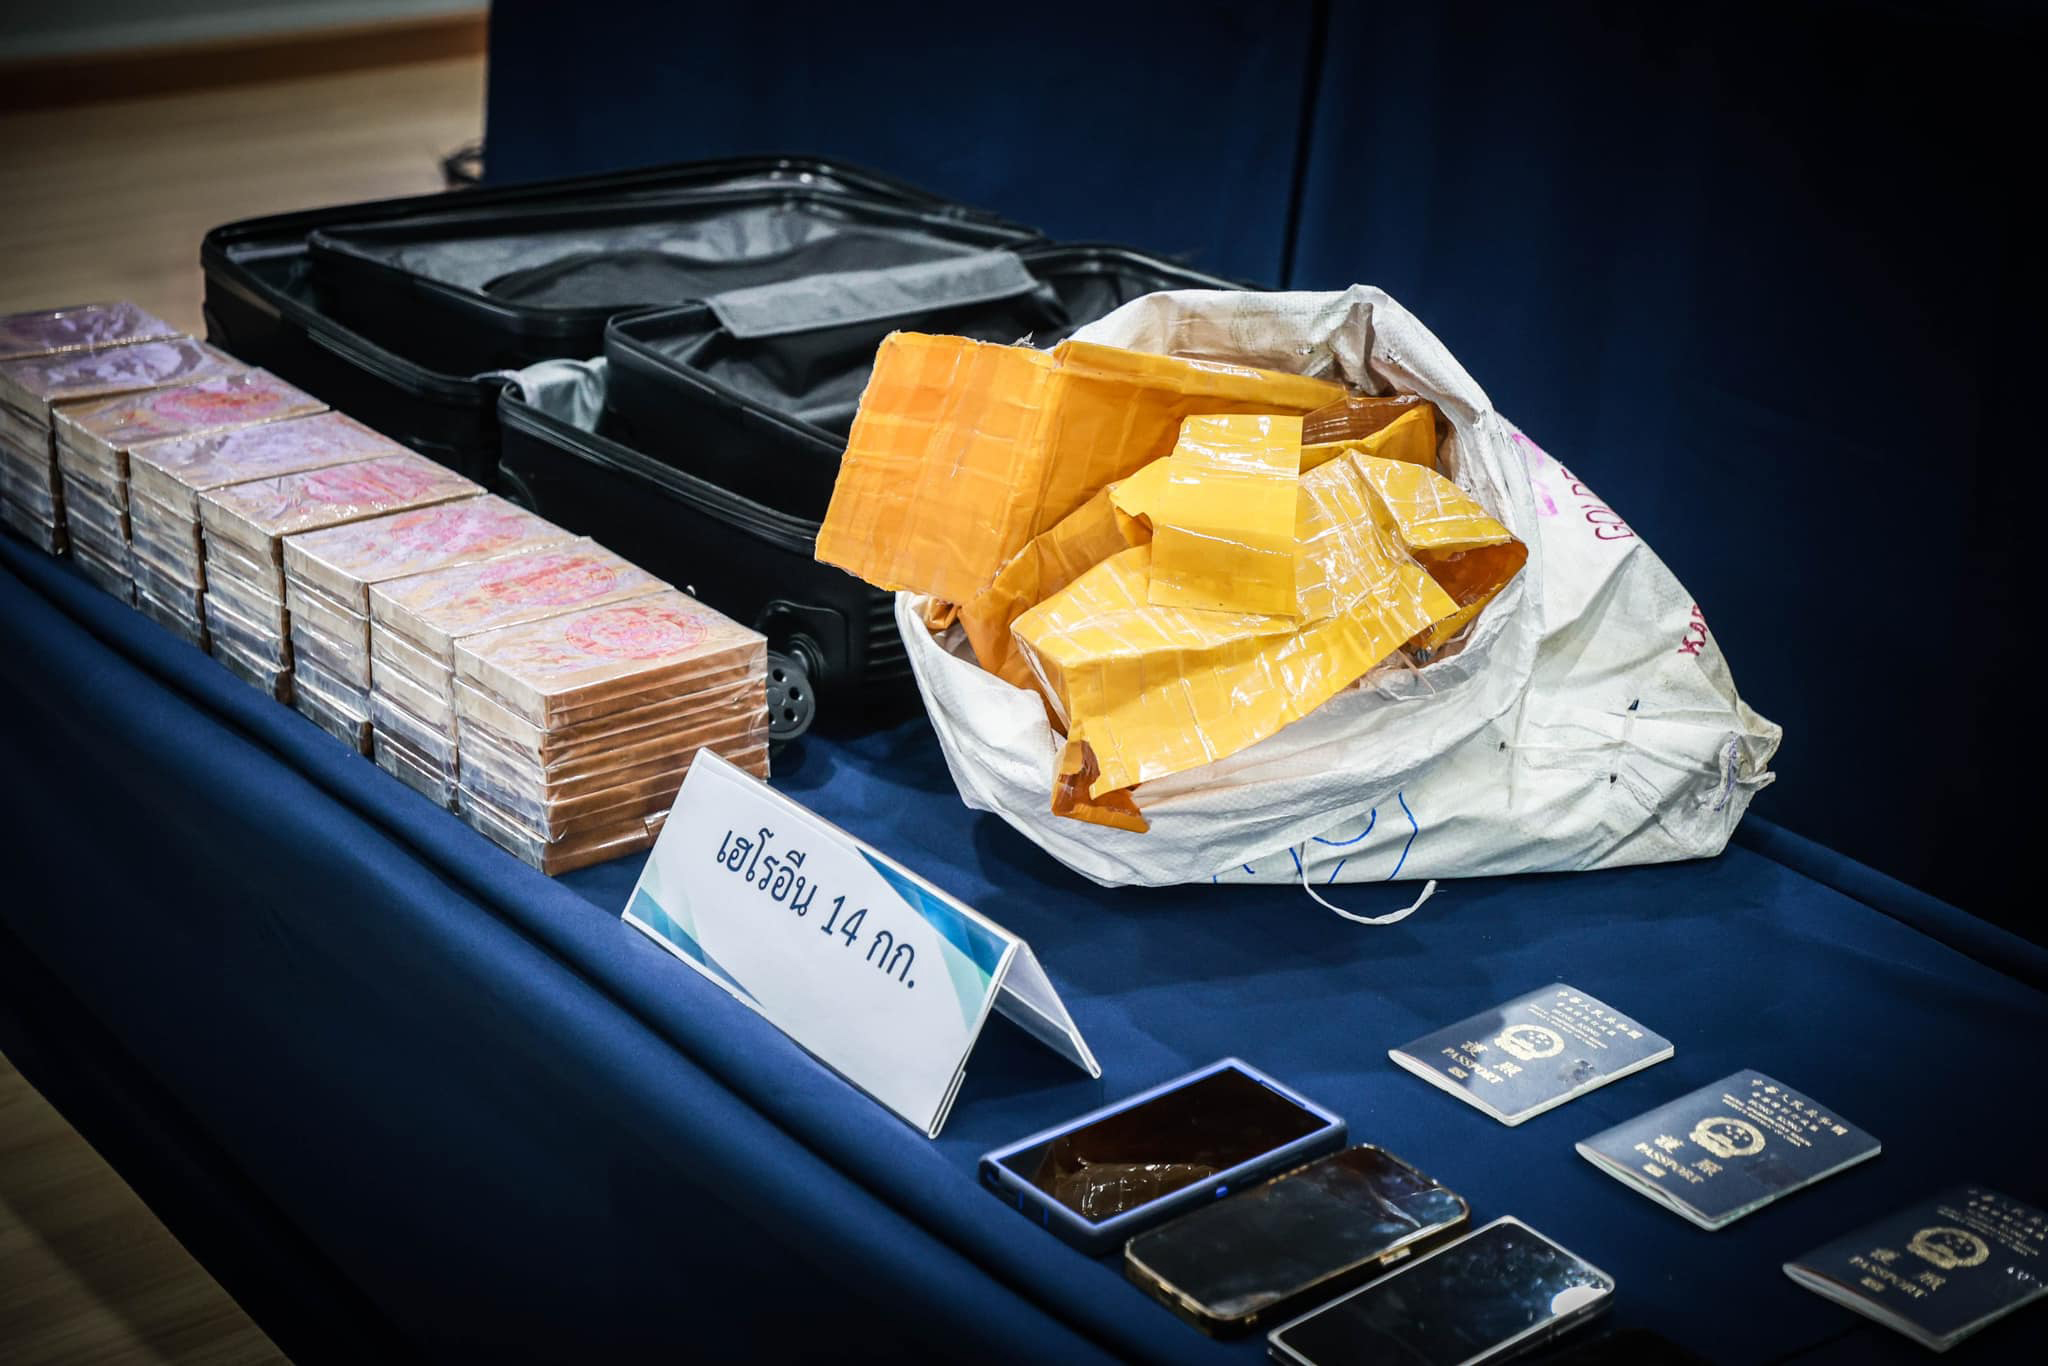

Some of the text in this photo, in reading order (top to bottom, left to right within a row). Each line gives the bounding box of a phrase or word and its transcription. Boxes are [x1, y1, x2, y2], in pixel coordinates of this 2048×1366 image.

[715, 827, 916, 989] เฮโรอีน 14 กก.
[1441, 1047, 1504, 1084] PASSPORT
